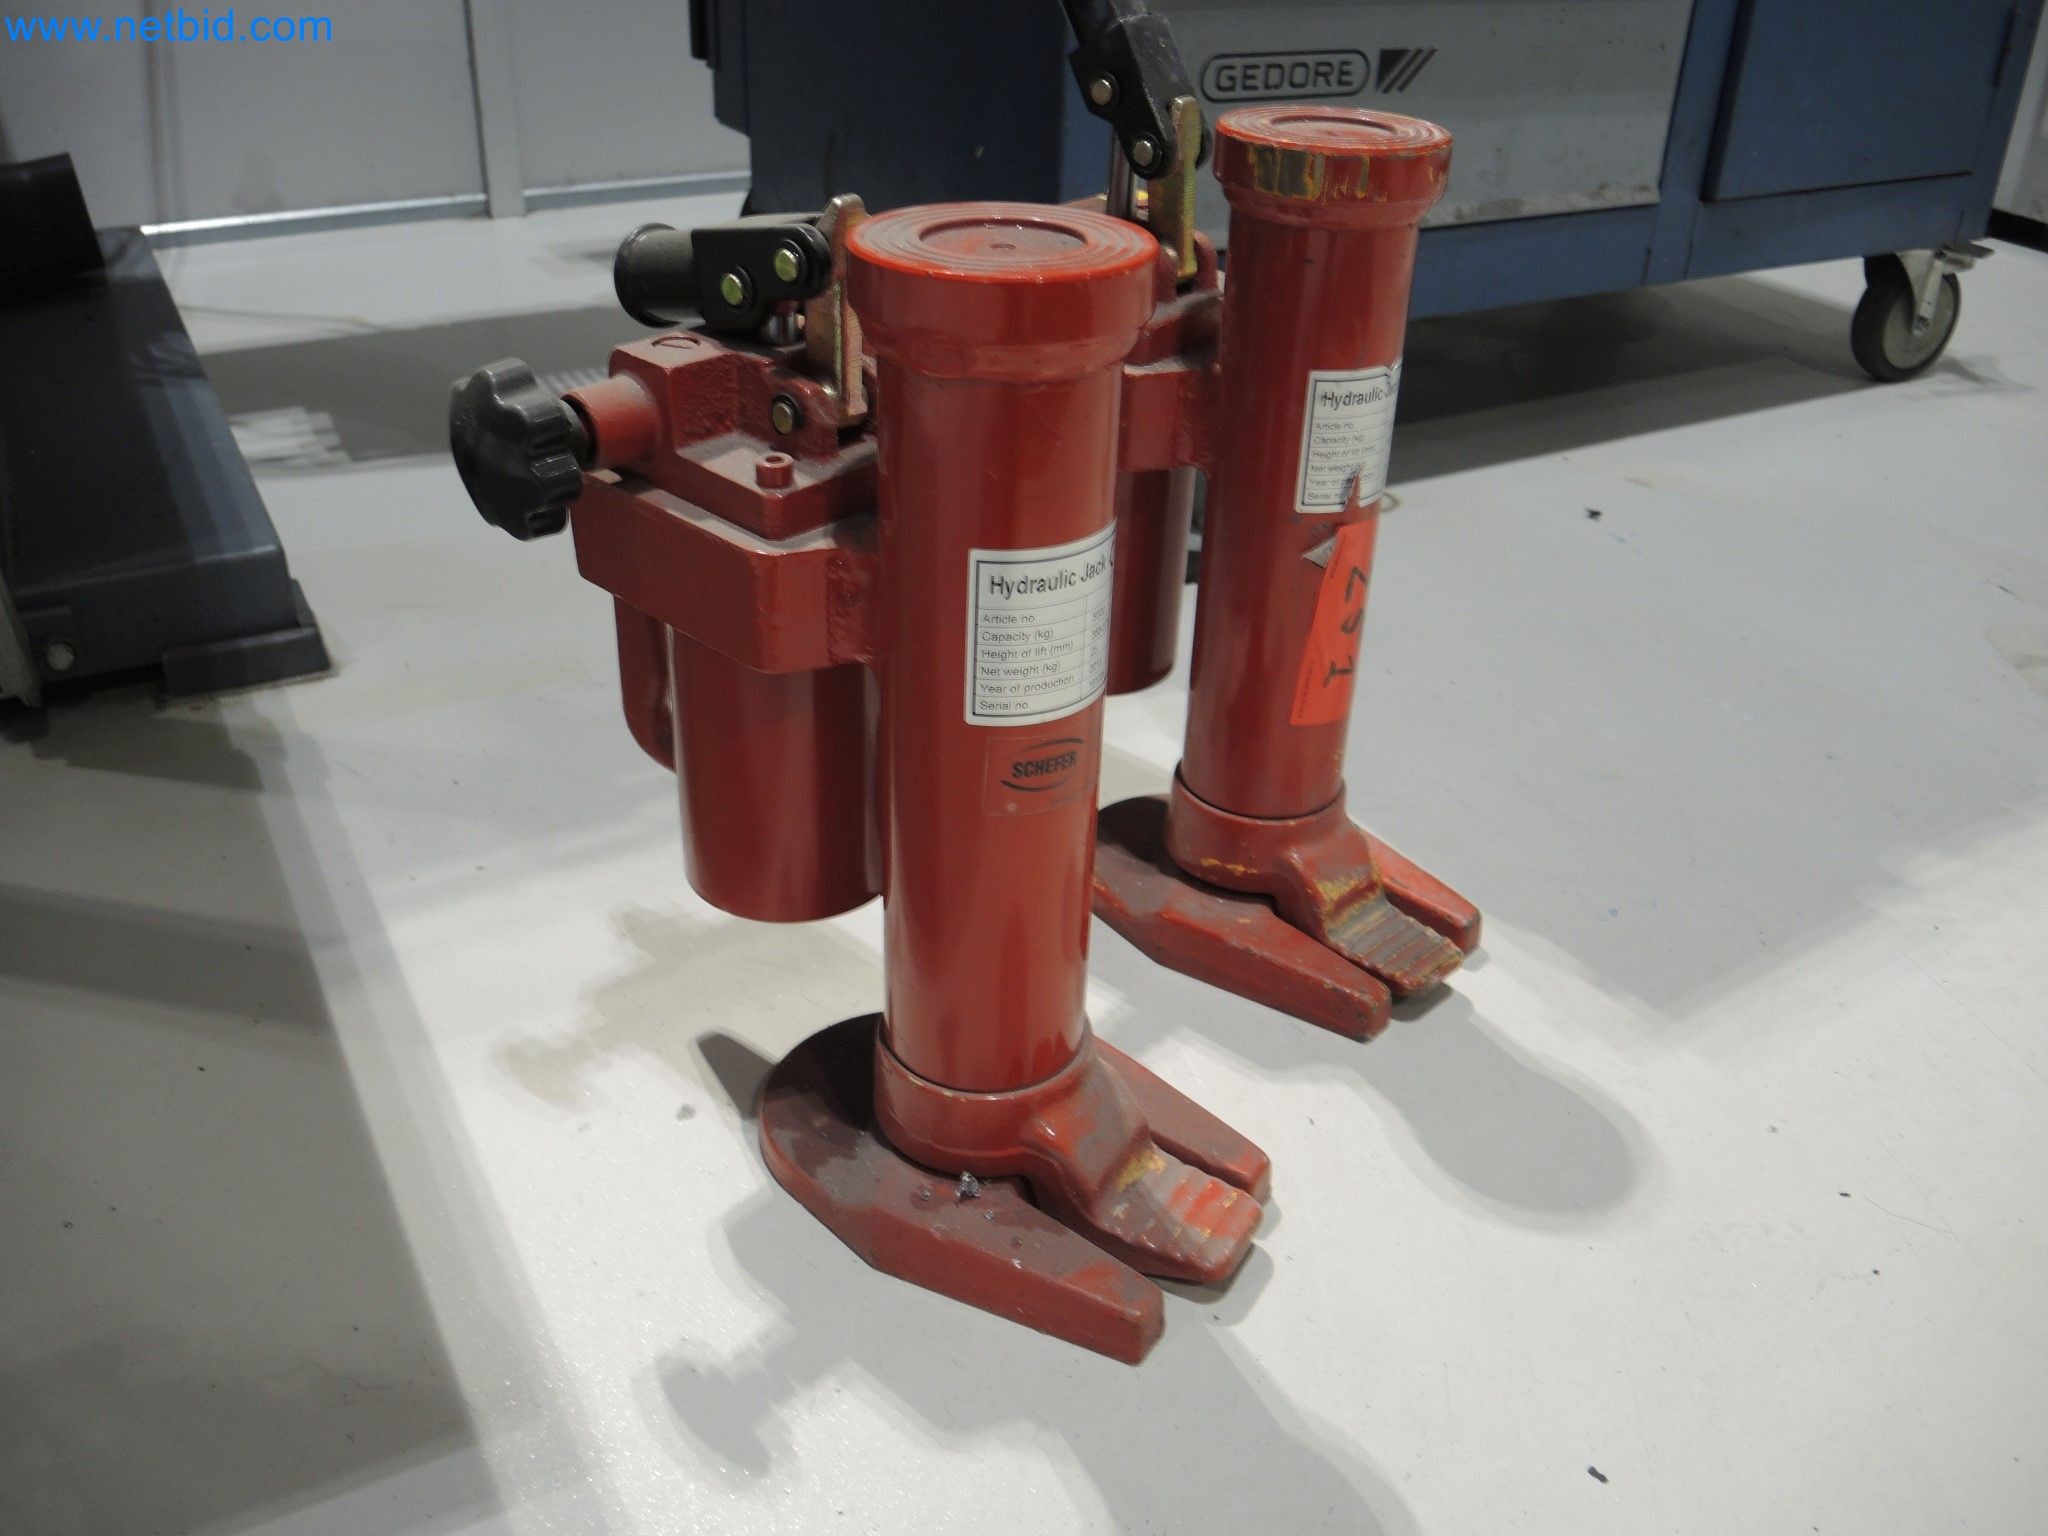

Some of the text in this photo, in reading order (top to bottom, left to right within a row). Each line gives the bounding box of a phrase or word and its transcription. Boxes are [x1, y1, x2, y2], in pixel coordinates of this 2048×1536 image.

[1215, 61, 1354, 93] GEDORE
[1322, 387, 1383, 411] Hydraulic
[1313, 436, 1349, 446] Capacity
[1312, 449, 1340, 460] Height
[990, 554, 1106, 600] Hydraulic Jack
[983, 614, 1018, 624] Article
[981, 629, 1054, 642] Capacity (kg)
[981, 641, 1074, 662] Height of lift (mm)
[981, 662, 1061, 678] Net weight (kg)
[980, 683, 1007, 693] Year
[1009, 682, 1023, 693] of
[1023, 675, 1075, 695] production
[979, 700, 1011, 711] Serial
[1012, 751, 1077, 779] SCHEFER
